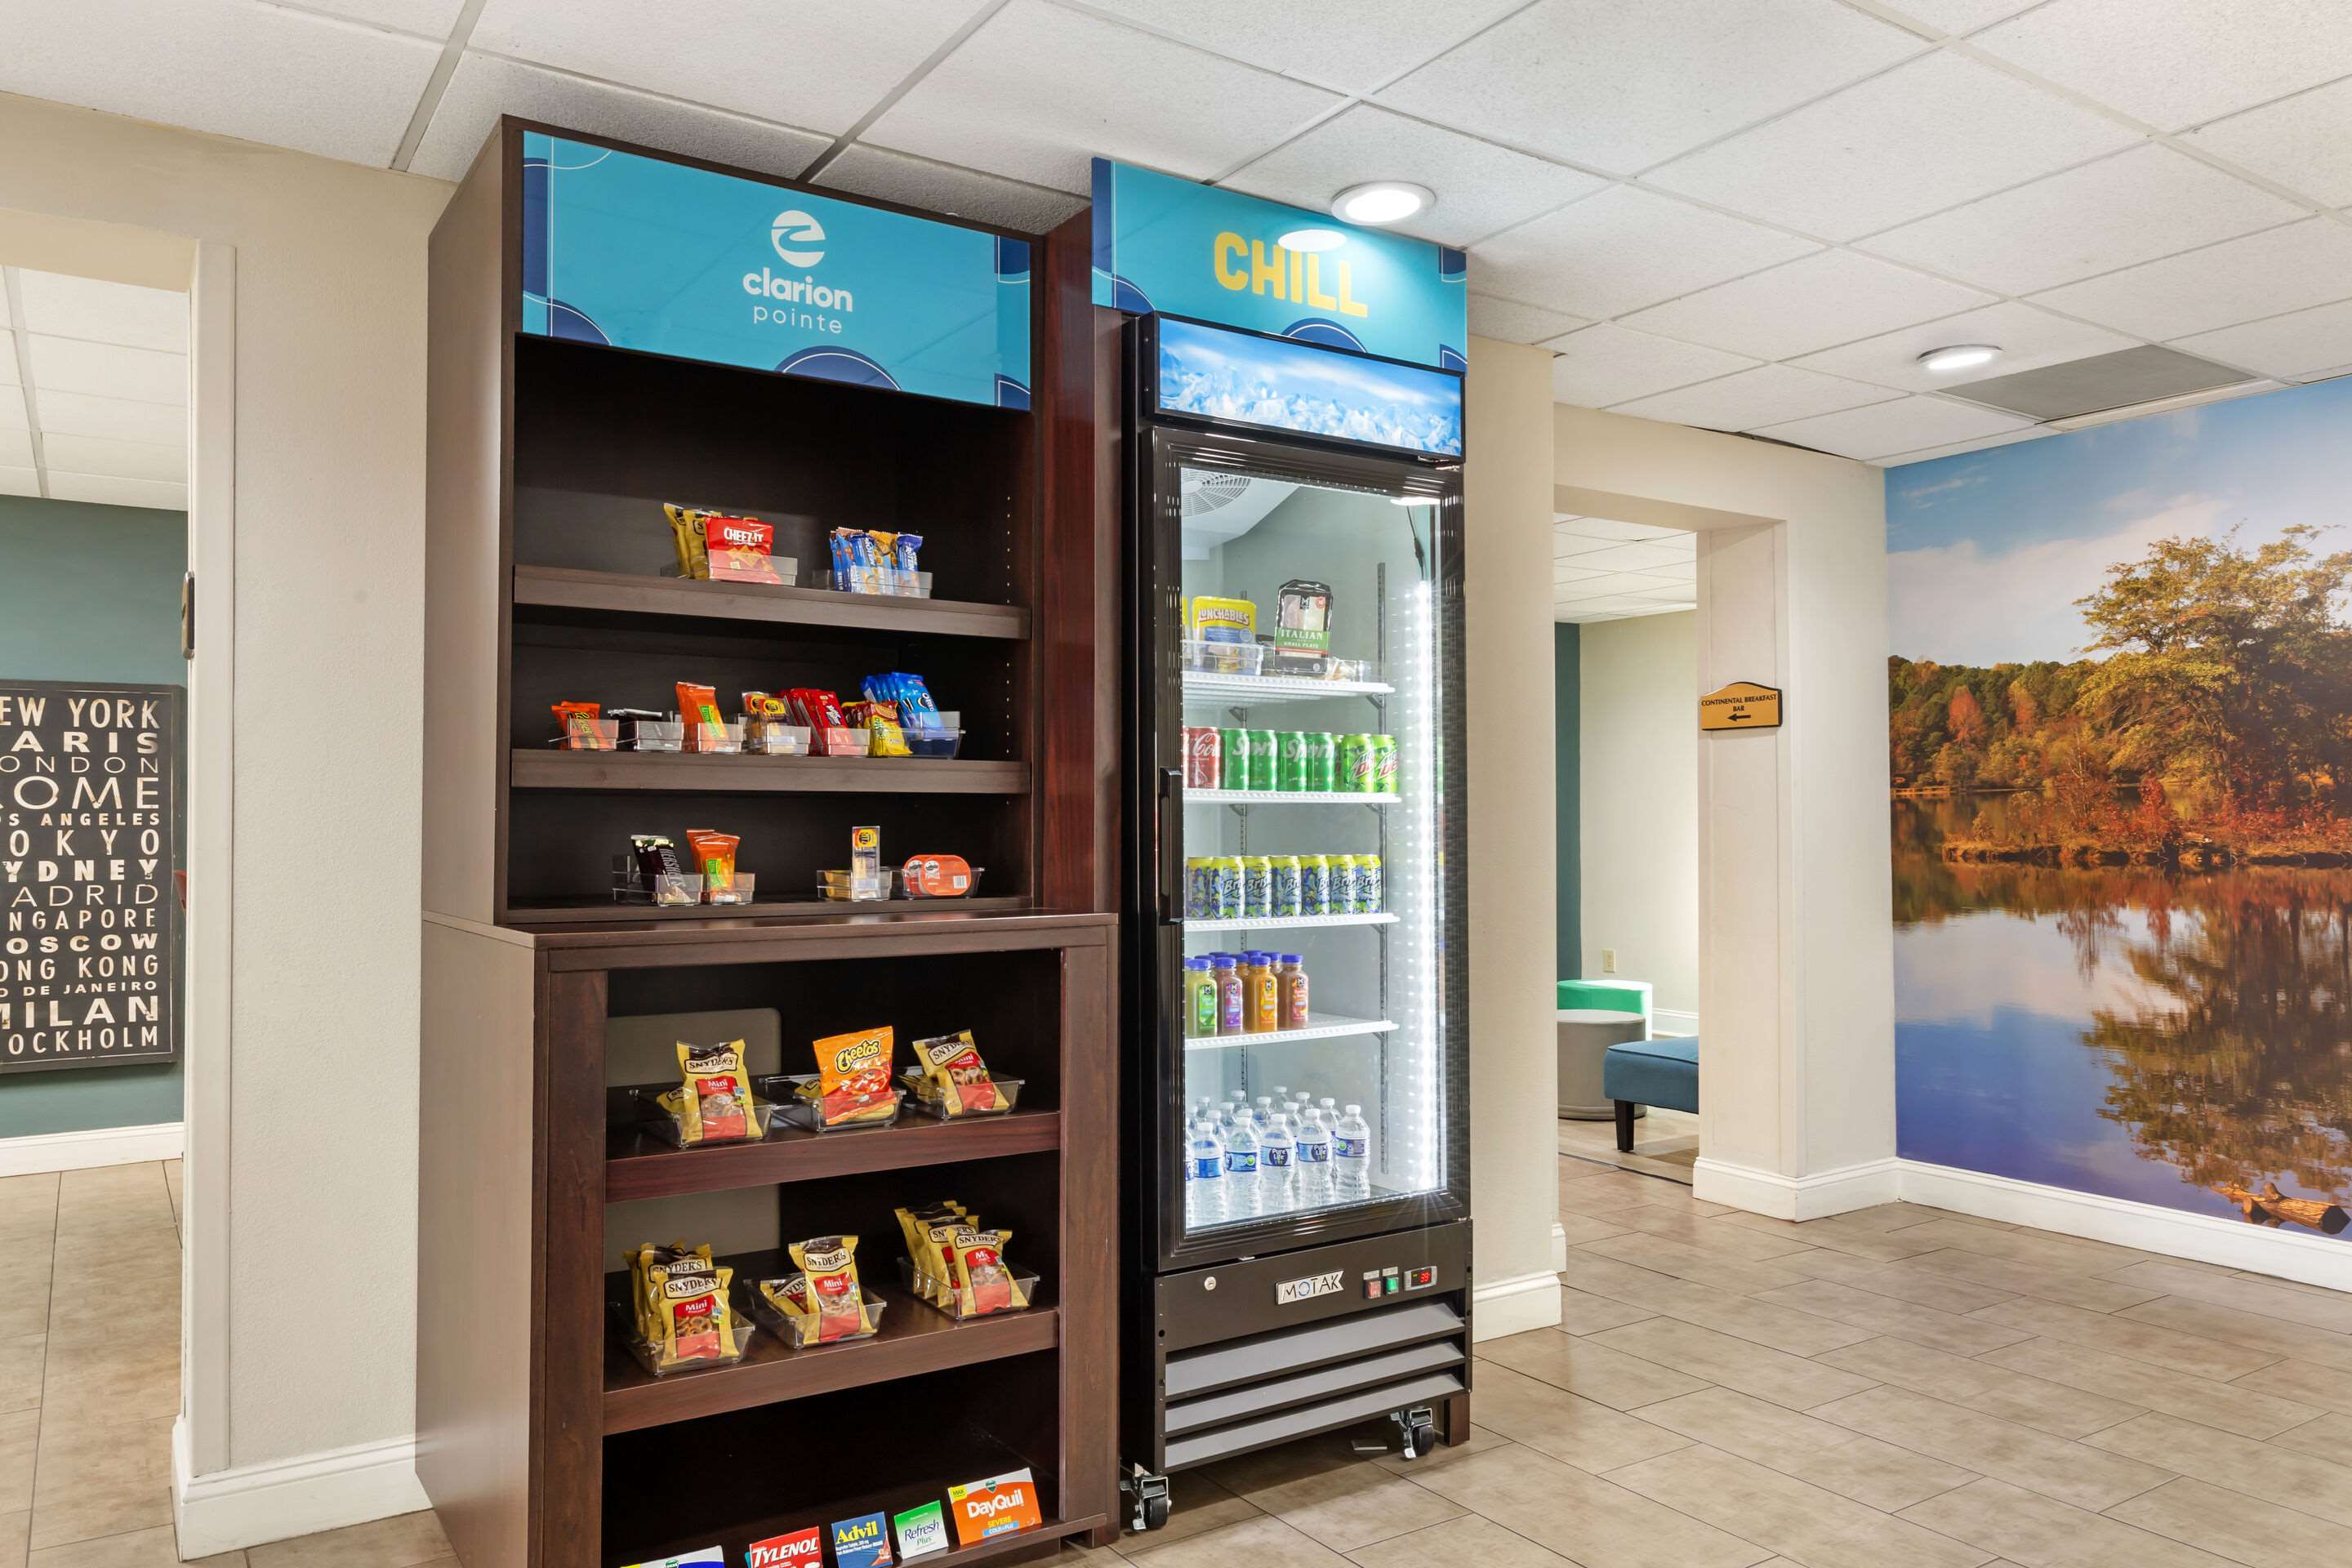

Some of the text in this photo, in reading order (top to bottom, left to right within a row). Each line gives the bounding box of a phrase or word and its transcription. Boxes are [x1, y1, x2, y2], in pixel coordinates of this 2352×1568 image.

[1214, 231, 1368, 318] CHILL
[742, 267, 853, 312] clarion
[753, 303, 844, 335] pointe
[1199, 608, 1250, 626] LUNCHABLES
[1281, 629, 1323, 641] ITALIAN
[1701, 693, 1777, 706] CONTINENTAL BREAKFAST
[68, 697, 160, 728] YORK
[11, 730, 158, 754] ARIS
[0, 755, 158, 773] ONDON
[0, 776, 159, 809] OME
[41, 813, 160, 826] ANGELES
[9, 828, 160, 858] OKYO
[2, 859, 159, 883] YDNEY
[11, 884, 159, 908] ADRID
[9, 907, 155, 932] NGAPORE
[6, 933, 158, 955] OSCOW
[78, 954, 158, 978] KONG
[23, 985, 51, 996] DE
[63, 981, 157, 995] JANEIRO
[8, 1026, 158, 1055] OCKHOLM
[933, 1040, 972, 1060] SNYD
[836, 1040, 880, 1074] Cheetos
[708, 1079, 728, 1089] Mini
[776, 1278, 807, 1298] YDE
[823, 1278, 843, 1288] Mini
[1281, 1273, 1339, 1301] MOTAK
[1420, 1272, 1431, 1283] 39
[685, 1299, 707, 1312] Mini
[967, 1489, 1024, 1518] DayQuil
[835, 1521, 879, 1544] Advil
[904, 1519, 939, 1542] Refresh
[916, 1535, 932, 1546] Plus
[751, 1537, 818, 1568] TYLENOL
